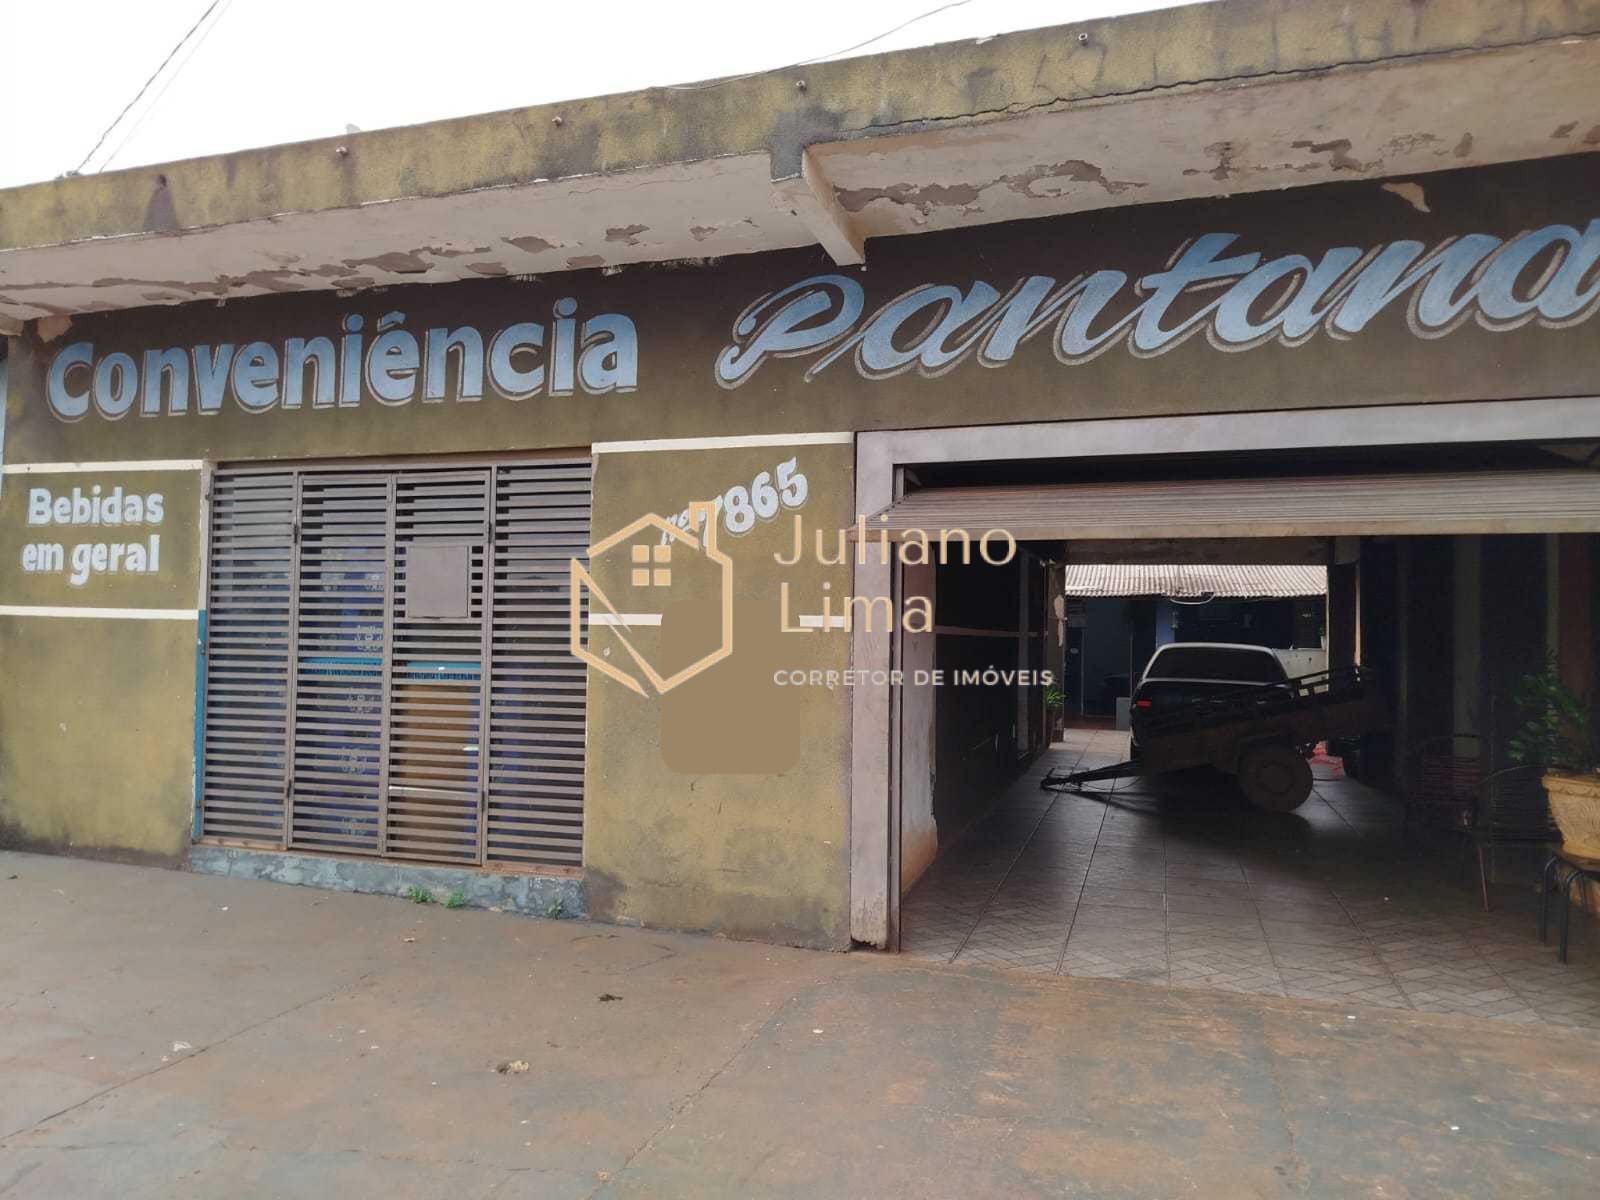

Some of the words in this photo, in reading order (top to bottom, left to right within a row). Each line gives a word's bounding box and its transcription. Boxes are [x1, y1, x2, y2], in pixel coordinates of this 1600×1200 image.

[46, 297, 638, 423] Conveniência
[28, 485, 164, 525] Bebidas
[23, 541, 64, 572] em
[70, 534, 160, 586] geral
